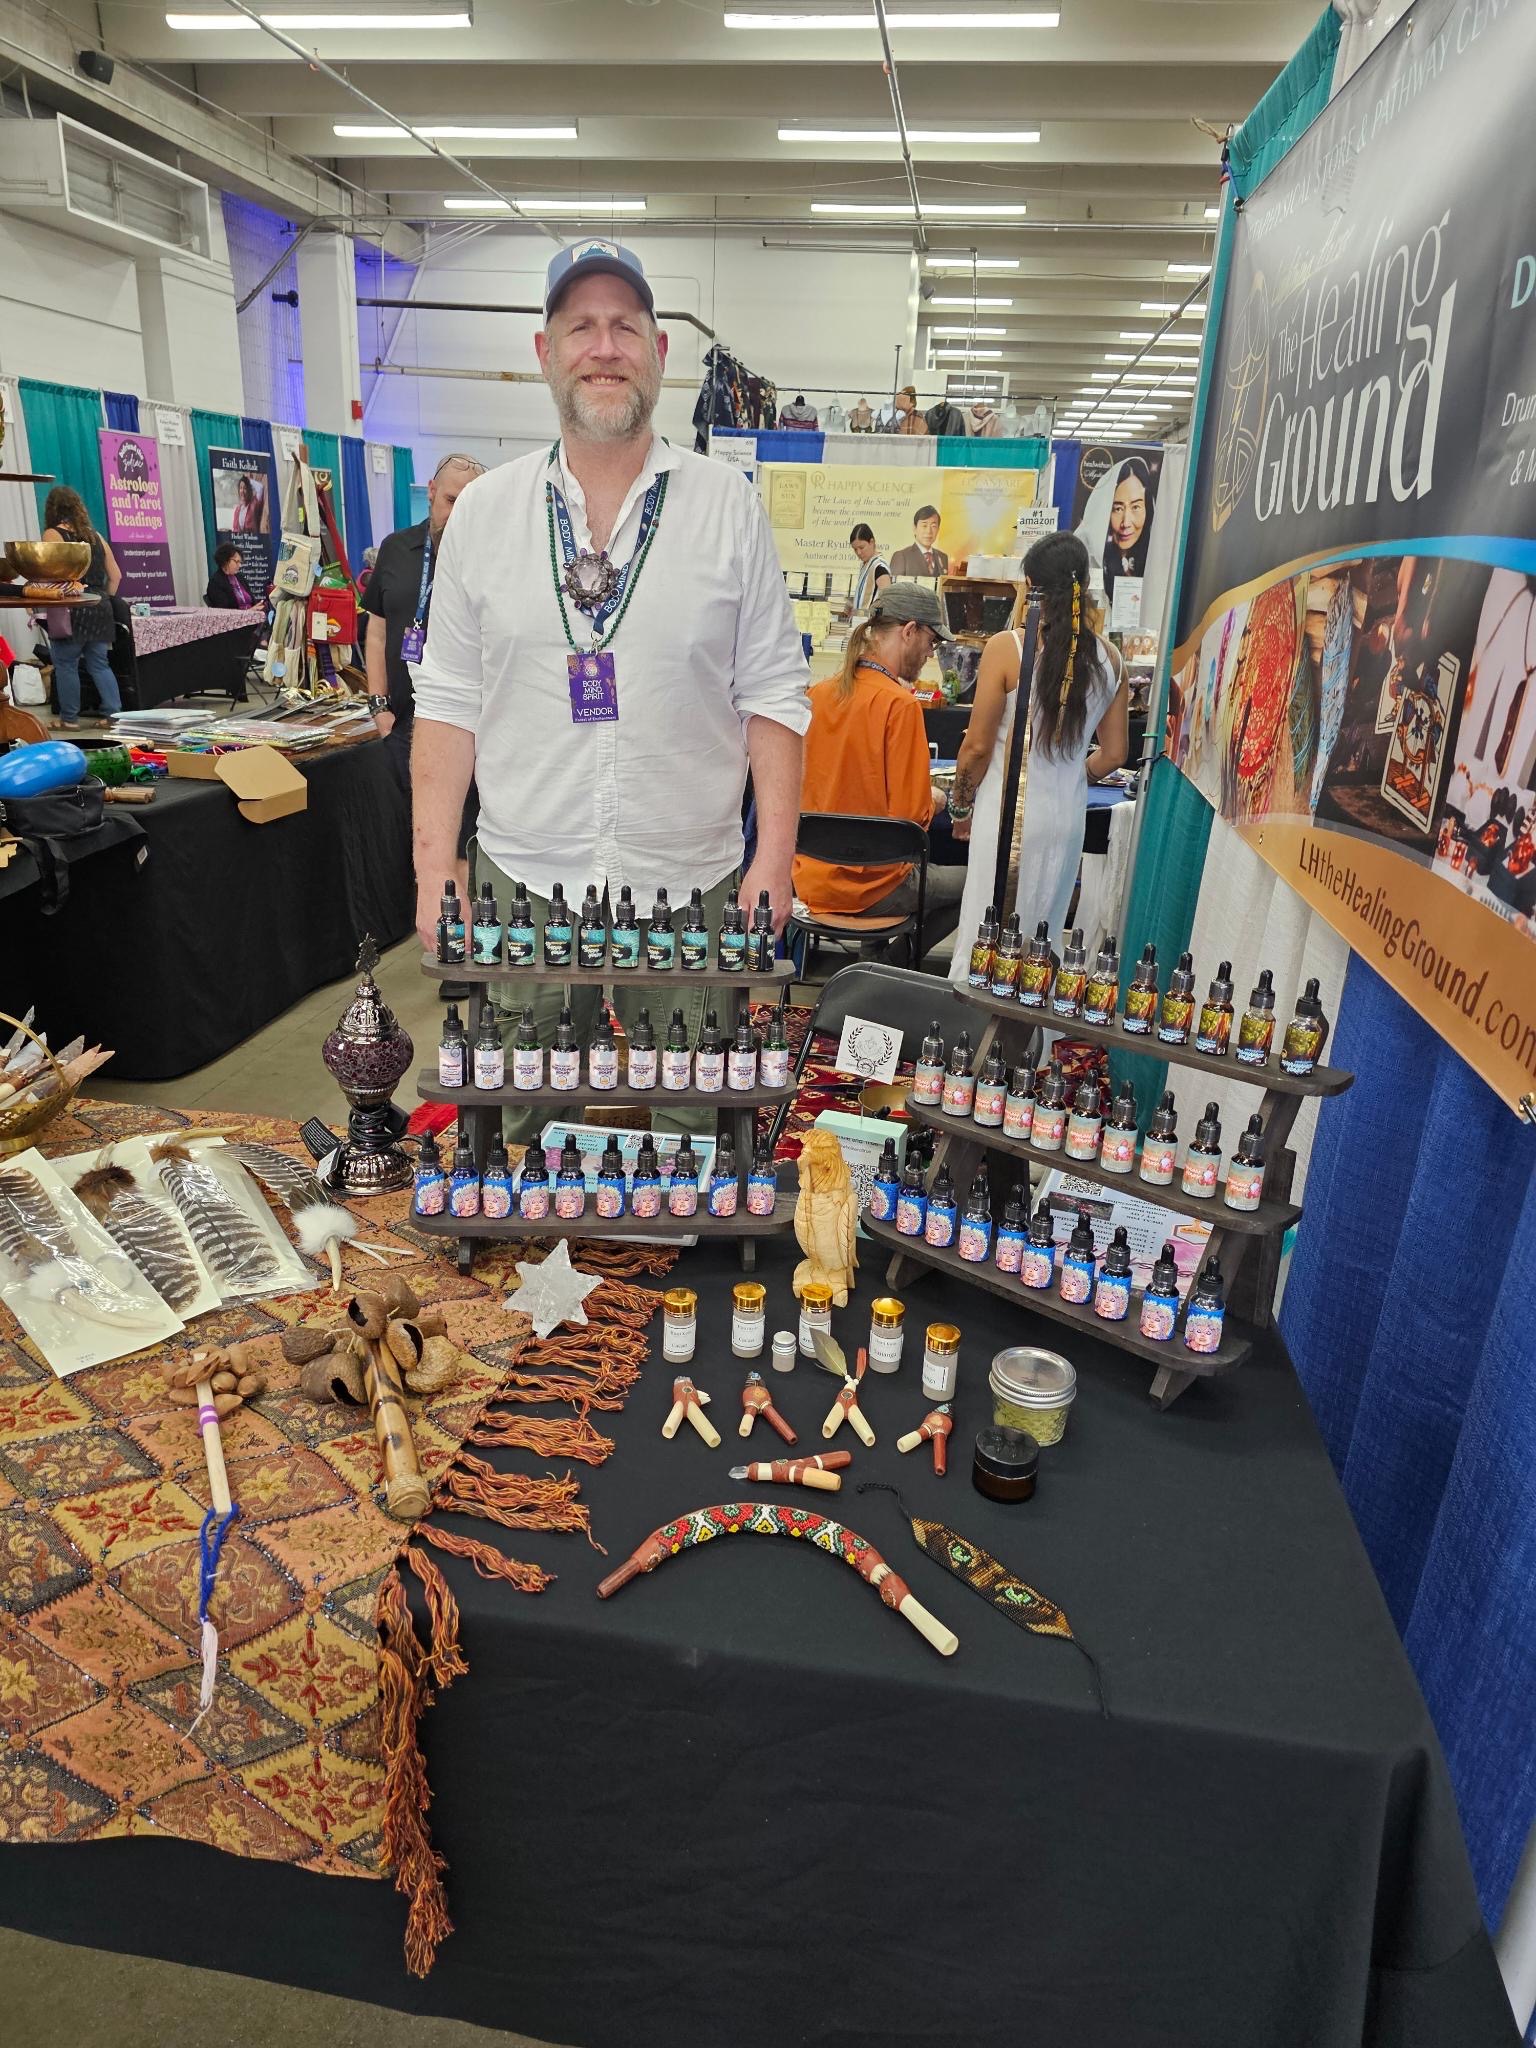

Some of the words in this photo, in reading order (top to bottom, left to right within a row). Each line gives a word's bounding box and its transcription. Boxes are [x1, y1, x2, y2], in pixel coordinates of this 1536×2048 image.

[1370, 32, 1450, 139] PATHWAY
[1273, 327, 1299, 382] The
[1297, 209, 1452, 398] Healing
[1255, 280, 1459, 522] Ground
[222, 457, 238, 469] Faith
[1510, 450, 1525, 485] &
[110, 474, 159, 496] Astrology
[827, 481, 864, 491] HAPPY
[866, 482, 916, 494] SCIENCE
[112, 493, 131, 508] and
[132, 494, 161, 510] Tarot
[644, 489, 656, 515] BODY
[833, 496, 852, 505] Laws
[863, 497, 875, 505] the
[895, 498, 911, 507] will
[812, 507, 837, 516] become
[839, 507, 851, 516] the
[852, 509, 882, 518] common
[1032, 510, 1043, 518] #1
[114, 509, 162, 530] Readings
[812, 518, 821, 528] of
[821, 518, 834, 527] the
[1019, 517, 1055, 526] amazon
[559, 518, 572, 544] BODY
[795, 538, 825, 549] Master
[803, 552, 829, 562] Author
[829, 552, 838, 562] of
[617, 564, 629, 590] MIND
[582, 680, 602, 688] BODY
[584, 686, 603, 694] MIND
[582, 692, 605, 701] SPIRIT
[576, 707, 614, 717] VENDOR
